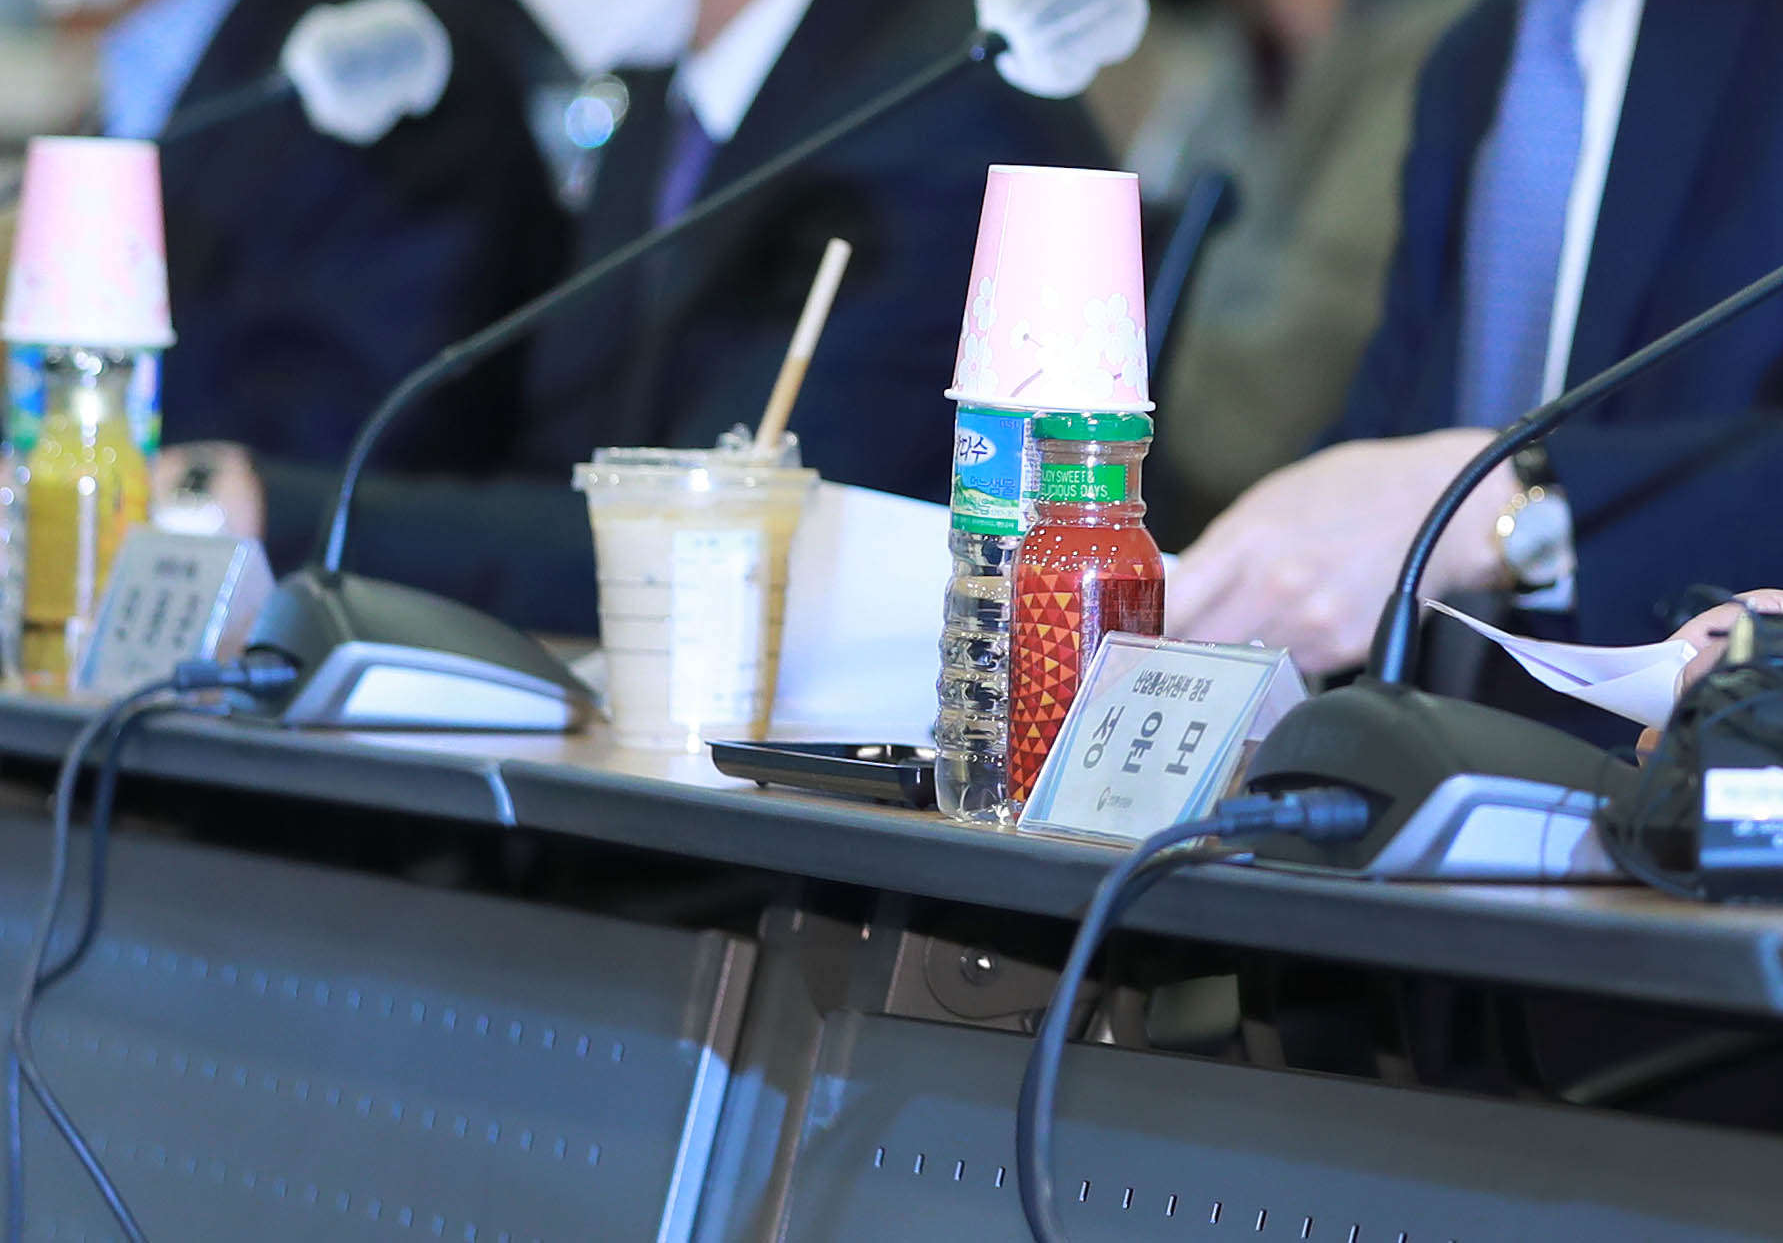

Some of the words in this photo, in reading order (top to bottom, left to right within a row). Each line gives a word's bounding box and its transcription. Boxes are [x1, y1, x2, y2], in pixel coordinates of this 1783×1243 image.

[957, 435, 988, 464] 다수
[1056, 470, 1086, 484] SWEET
[1041, 483, 1077, 498] ELICIOUS
